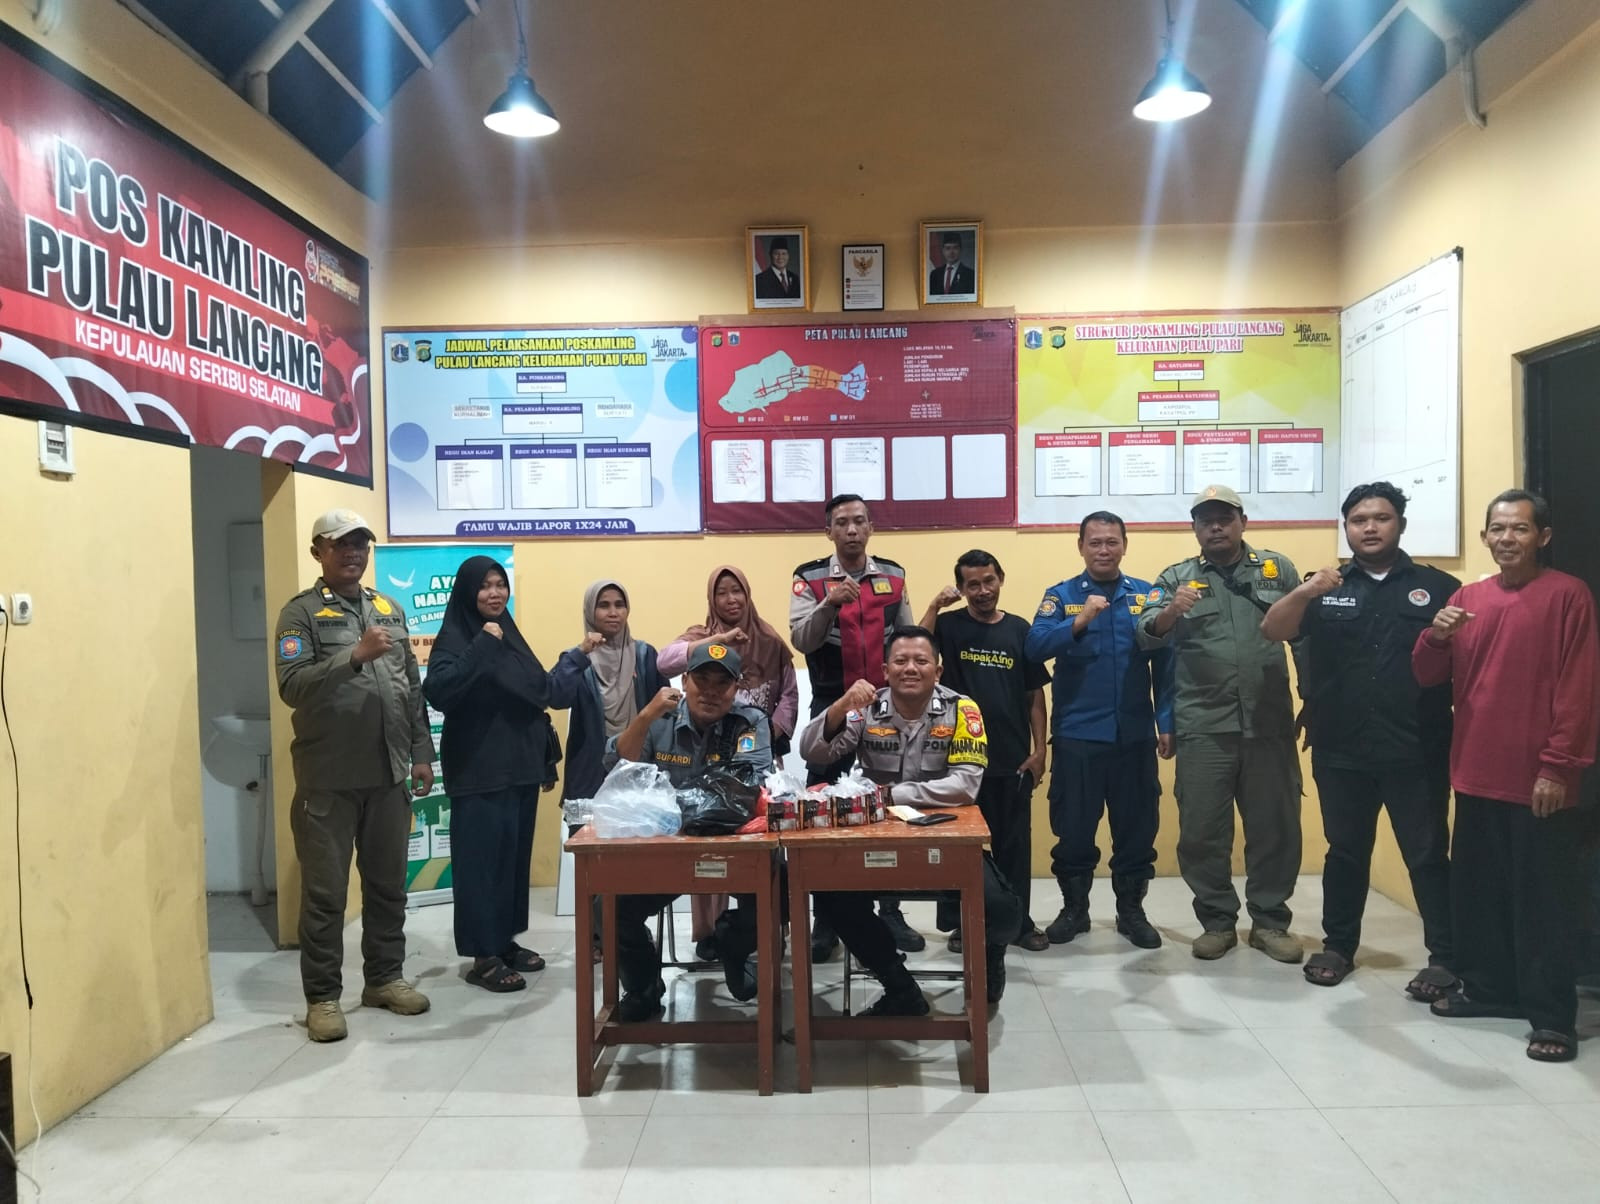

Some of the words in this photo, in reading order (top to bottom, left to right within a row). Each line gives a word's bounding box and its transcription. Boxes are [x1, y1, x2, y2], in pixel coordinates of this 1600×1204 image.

[54, 134, 147, 247] POS
[157, 193, 306, 325] KAMLING
[25, 215, 174, 340] PULAU
[184, 285, 323, 395] LANCANG
[805, 329, 828, 340] PETA
[832, 328, 862, 340] PULAU
[864, 327, 908, 339] LANCANG
[1075, 324, 1130, 339] STRUKTUR
[1132, 322, 1199, 338] POSKAMLING
[1201, 321, 1235, 336] PULAU
[1237, 321, 1284, 336] LANCANG
[1294, 321, 1311, 333] JAGA
[651, 337, 668, 349] JAGA
[1298, 332, 1329, 343] JAKARTA
[446, 338, 488, 353] JADWAL
[489, 337, 564, 352] PELAKSANAAN
[565, 336, 636, 351] POSKAMLING
[1117, 339, 1179, 354] KELURAHAN
[1180, 338, 1214, 353] PULAU
[1215, 338, 1243, 352] PARI
[656, 347, 687, 357] JAKARTA
[75, 318, 185, 375] KEPULAUAN
[190, 359, 247, 394] SERIBU
[249, 378, 301, 412] SELATAN
[435, 355, 470, 369] PULAU
[471, 354, 520, 369] LANCANG
[522, 353, 584, 367] KELURAHAN
[585, 353, 620, 367] PULAU
[621, 352, 647, 366] PARI
[463, 521, 495, 532] TAMU
[497, 521, 532, 531] WAJIB
[535, 520, 571, 531] LAPOR
[575, 520, 602, 530] 1X24
[604, 520, 628, 530] JAM
[408, 616, 420, 625] DI
[864, 739, 899, 752] TULUS
[656, 751, 692, 765] SUPARDI
